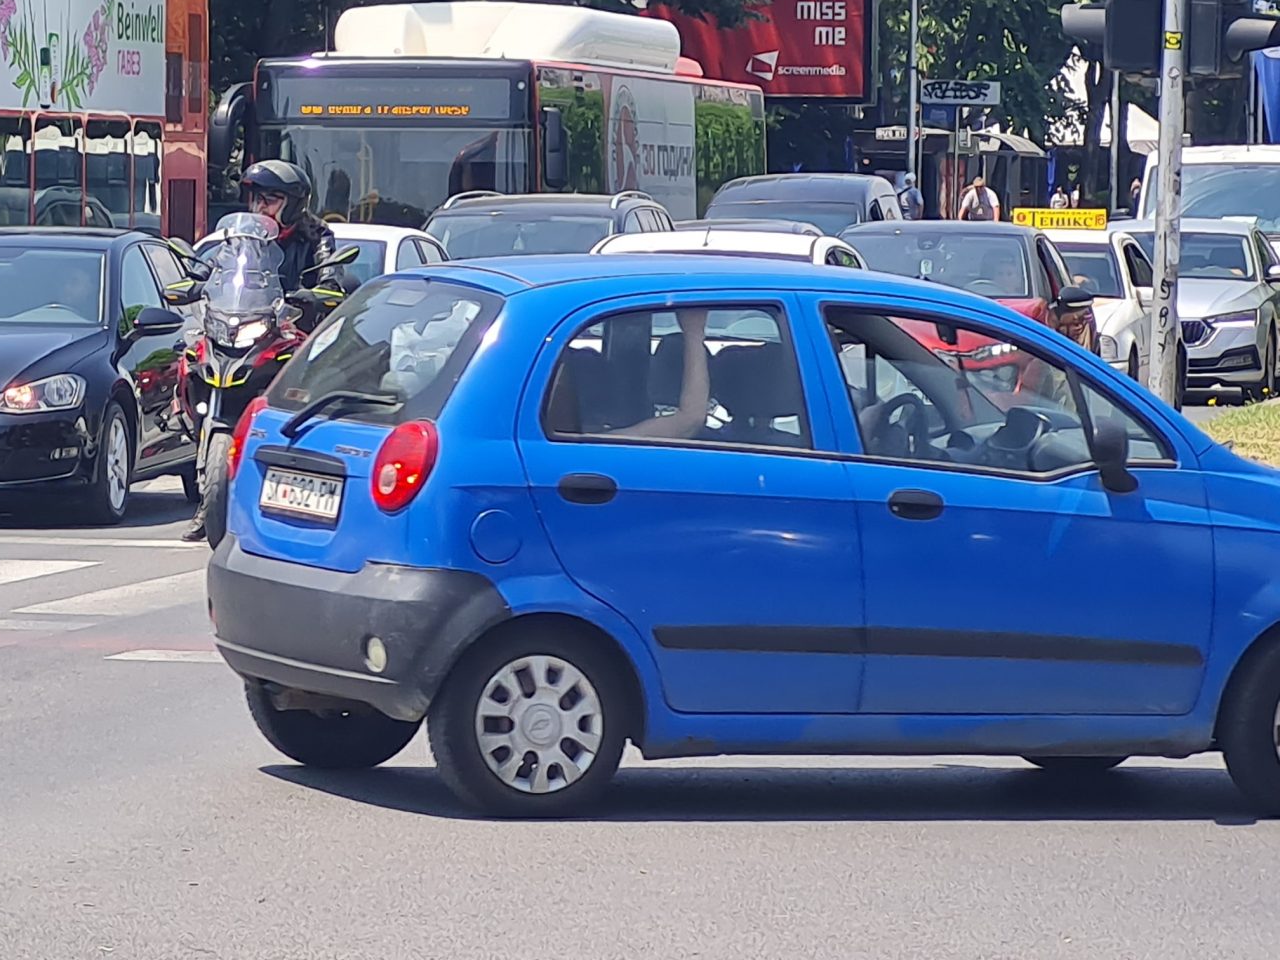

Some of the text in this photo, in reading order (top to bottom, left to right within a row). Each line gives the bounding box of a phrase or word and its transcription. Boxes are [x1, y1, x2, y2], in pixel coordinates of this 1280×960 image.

[815, 27, 846, 46] me
[778, 64, 846, 76] screenmedia
[642, 144, 656, 175] 30
